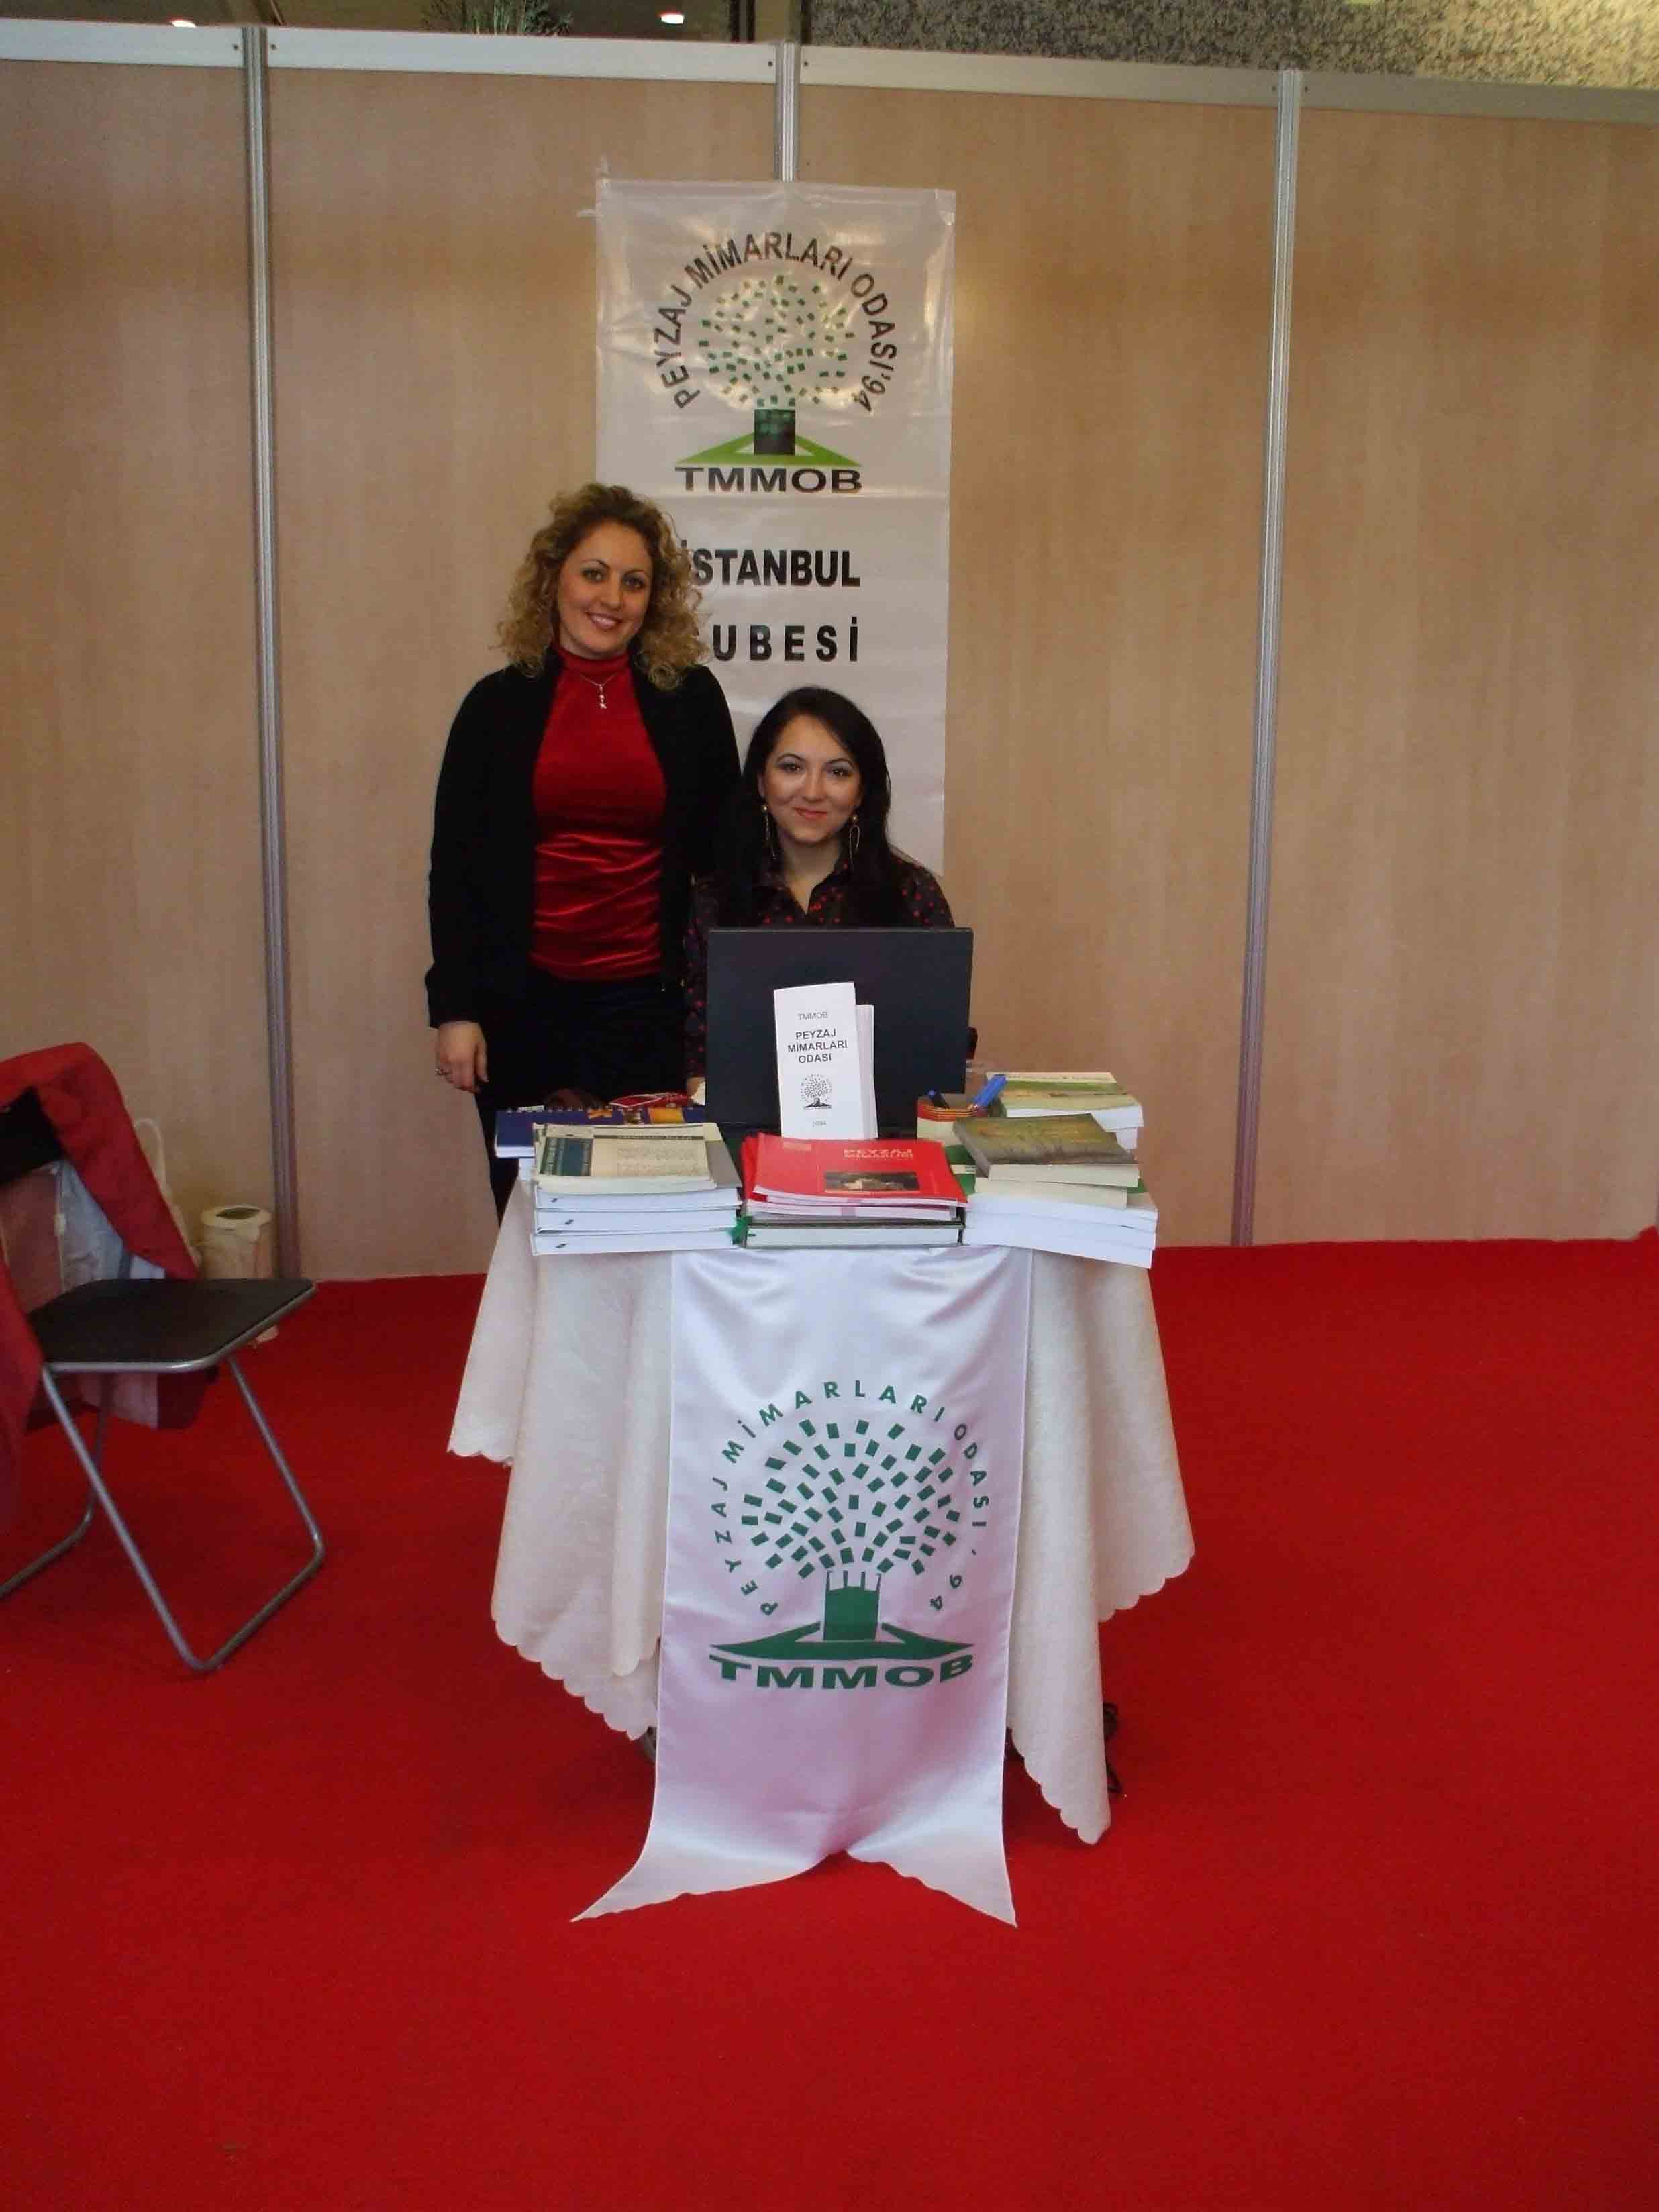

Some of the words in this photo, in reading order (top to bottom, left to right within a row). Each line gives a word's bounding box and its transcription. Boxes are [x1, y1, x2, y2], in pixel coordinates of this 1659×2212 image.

[654, 285, 700, 409] PEYZAJ
[684, 232, 854, 289] MİMARLARI
[674, 466, 863, 493] TMMOB
[681, 539, 860, 587] STANBUL
[713, 616, 858, 662] UBESİ
[795, 1028, 836, 1040] PEYZAJ
[799, 1053, 832, 1064] ODASI
[721, 1379, 945, 1464] MİMARLARI
[711, 1476, 778, 1616] PEYZAJ
[709, 1653, 974, 1689] TMMOB
